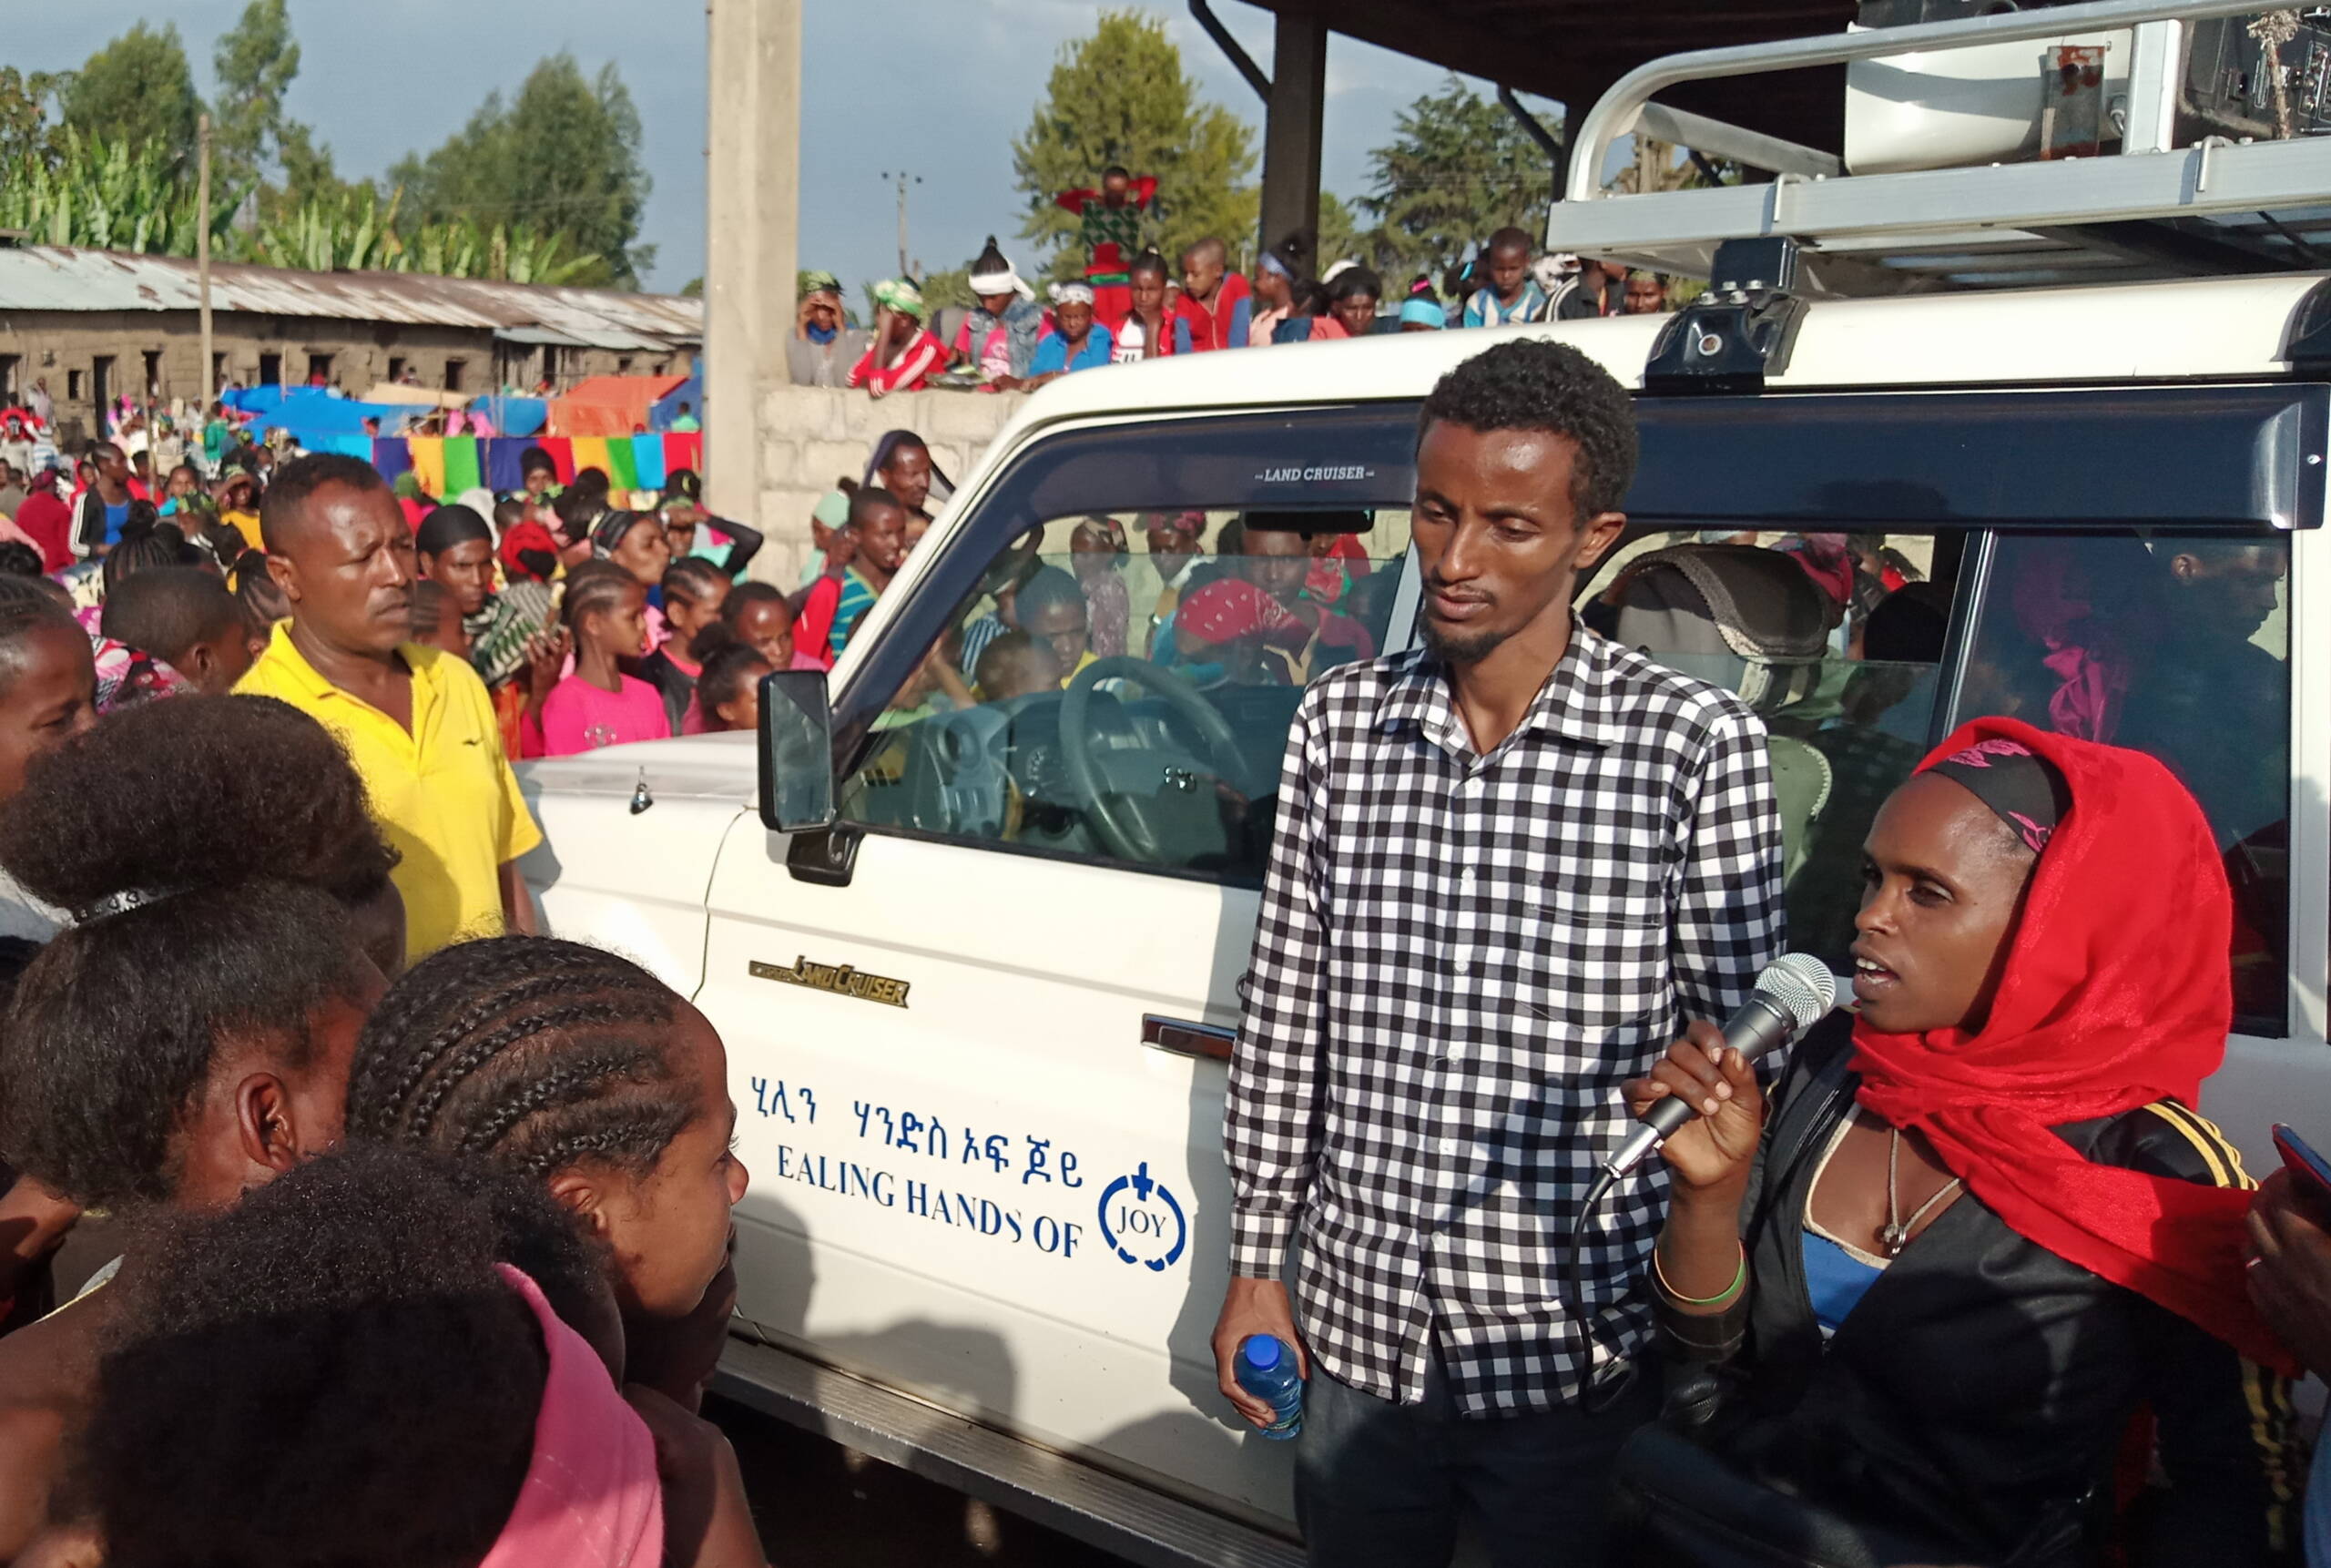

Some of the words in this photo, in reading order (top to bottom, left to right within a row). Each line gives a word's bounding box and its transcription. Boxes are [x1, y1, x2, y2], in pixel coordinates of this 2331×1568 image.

[1264, 467, 1302, 483] LAND
[1303, 465, 1366, 482] CRUISER
[778, 1145, 895, 1207] EALING
[906, 1179, 1023, 1244] HANDS
[1033, 1216, 1084, 1258] OF
[1116, 1206, 1167, 1239] JOY
